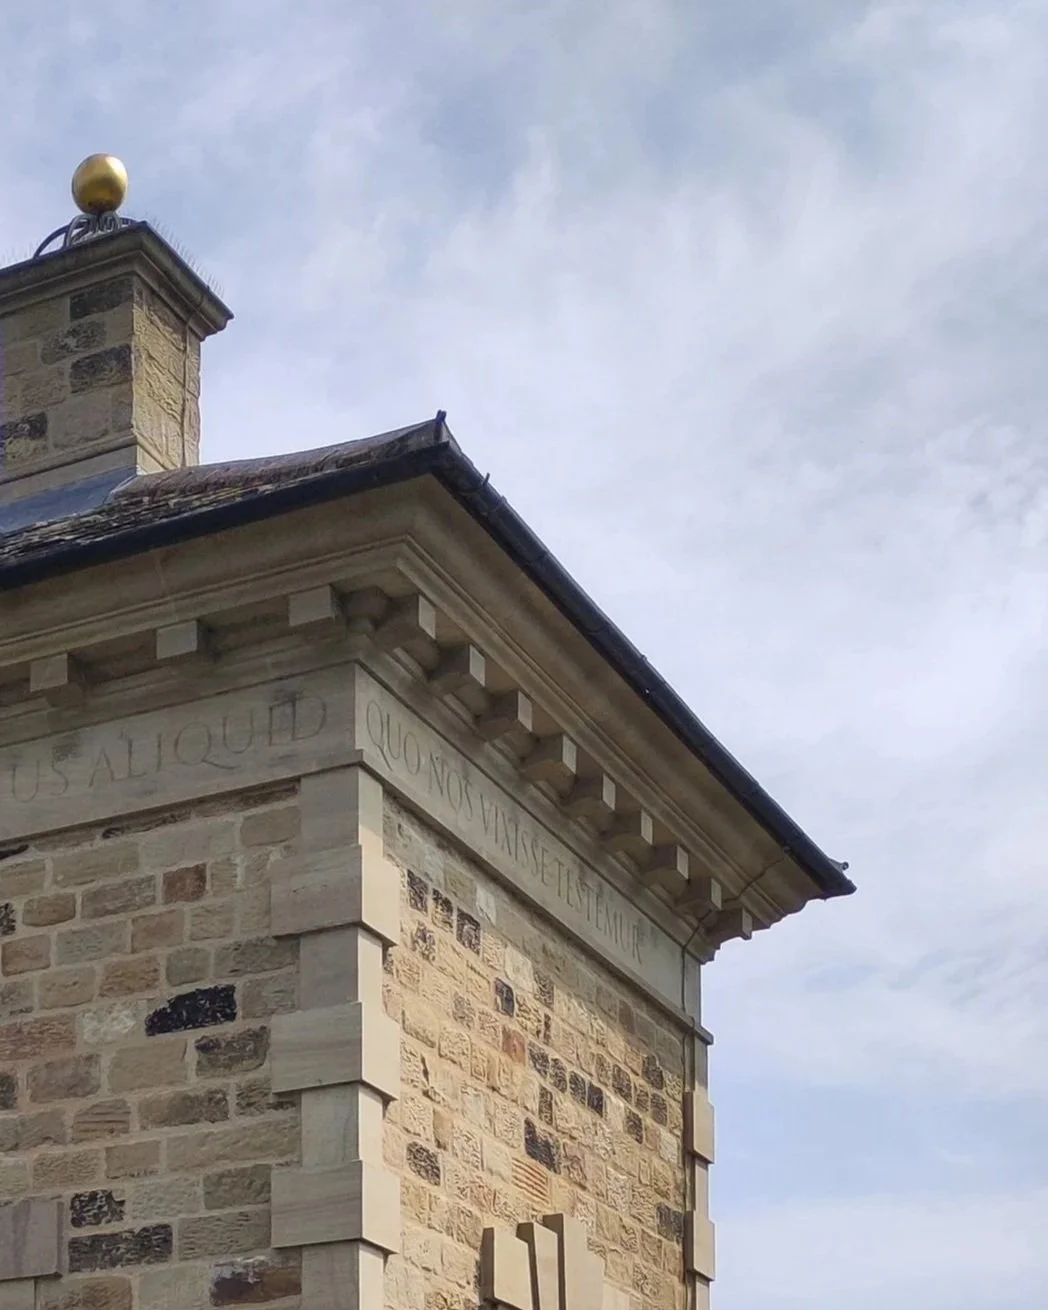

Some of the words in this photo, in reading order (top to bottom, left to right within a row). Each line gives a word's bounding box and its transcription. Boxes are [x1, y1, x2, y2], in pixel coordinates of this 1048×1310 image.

[89, 693, 328, 787] ALIQUID
[366, 700, 421, 775] QUO
[426, 752, 473, 822] NOS
[479, 793, 550, 886] VIXISSE
[554, 858, 643, 965] TESTEMUR
